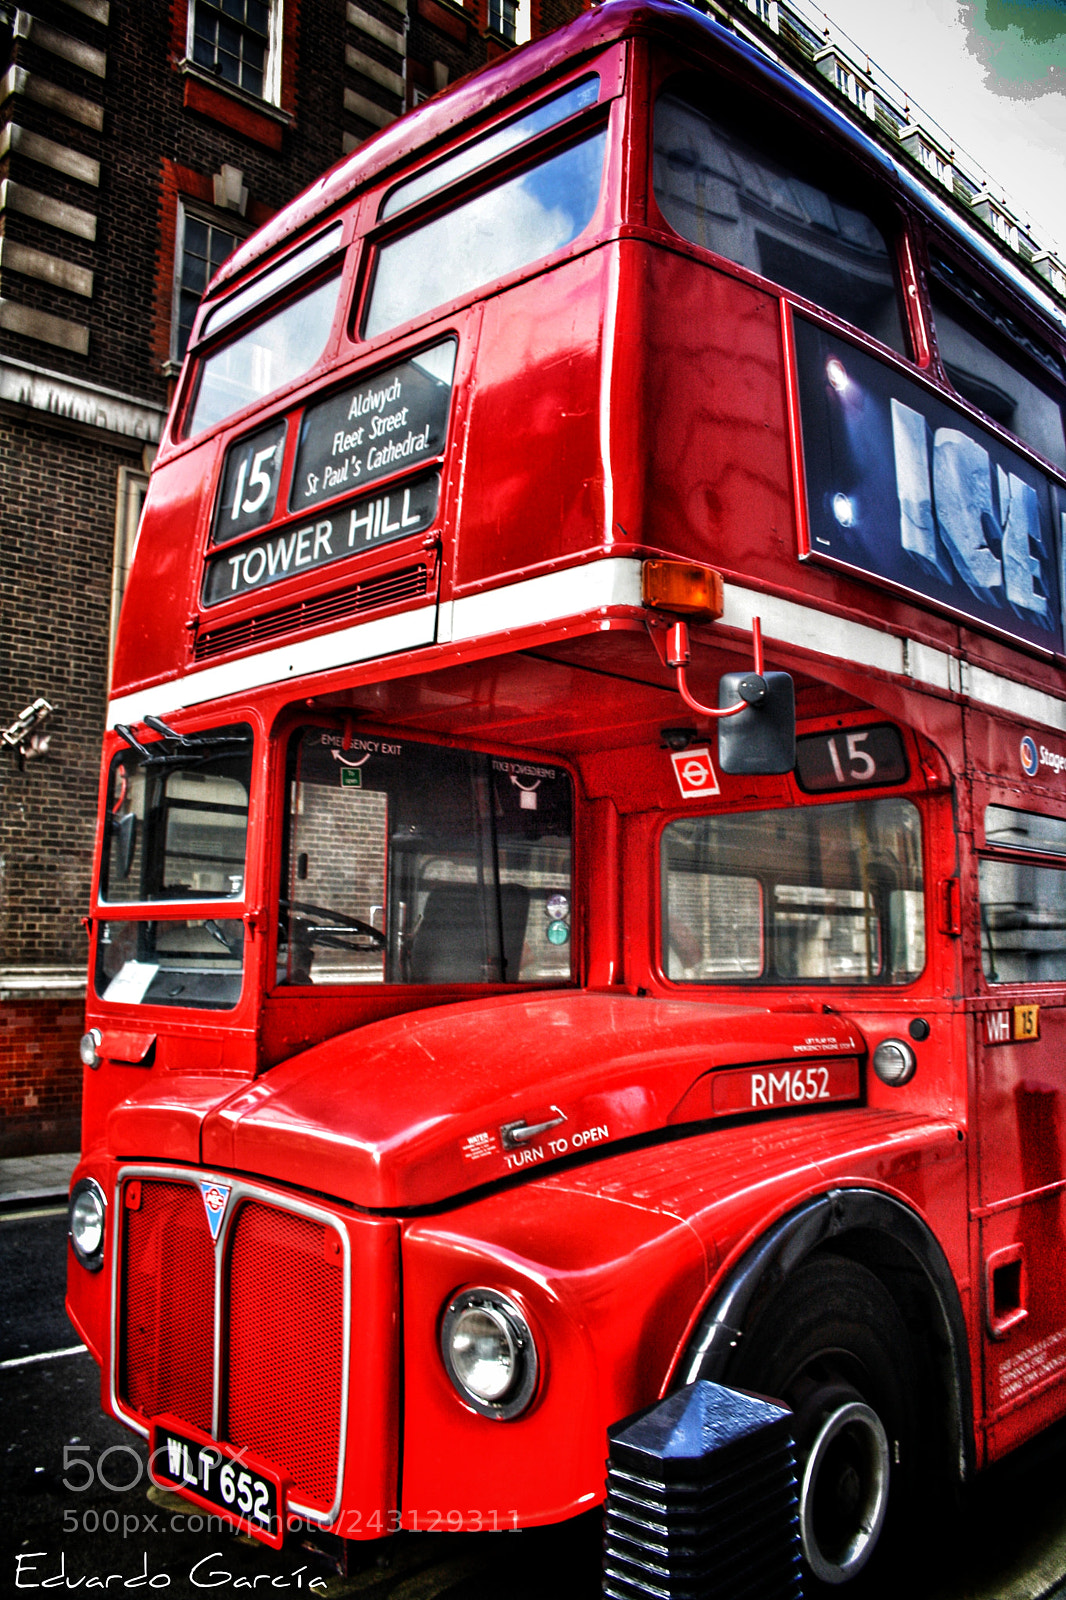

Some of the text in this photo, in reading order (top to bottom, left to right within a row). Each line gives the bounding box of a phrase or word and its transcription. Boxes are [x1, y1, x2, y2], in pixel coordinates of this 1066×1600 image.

[348, 377, 401, 420] Aldwych
[332, 407, 409, 456] Fleet Street
[231, 445, 277, 520] 15
[228, 488, 421, 590] TOWER HILL
[320, 733, 402, 756] EMEGENCY EXIT
[827, 732, 877, 783] 15
[984, 1011, 1010, 1042] WH
[1022, 1010, 1034, 1035] 15
[750, 1067, 832, 1107] RM652
[503, 1145, 545, 1169] TURN
[547, 1138, 569, 1155] TO
[571, 1124, 610, 1148] OPEN
[167, 1437, 270, 1524] WLT 652
